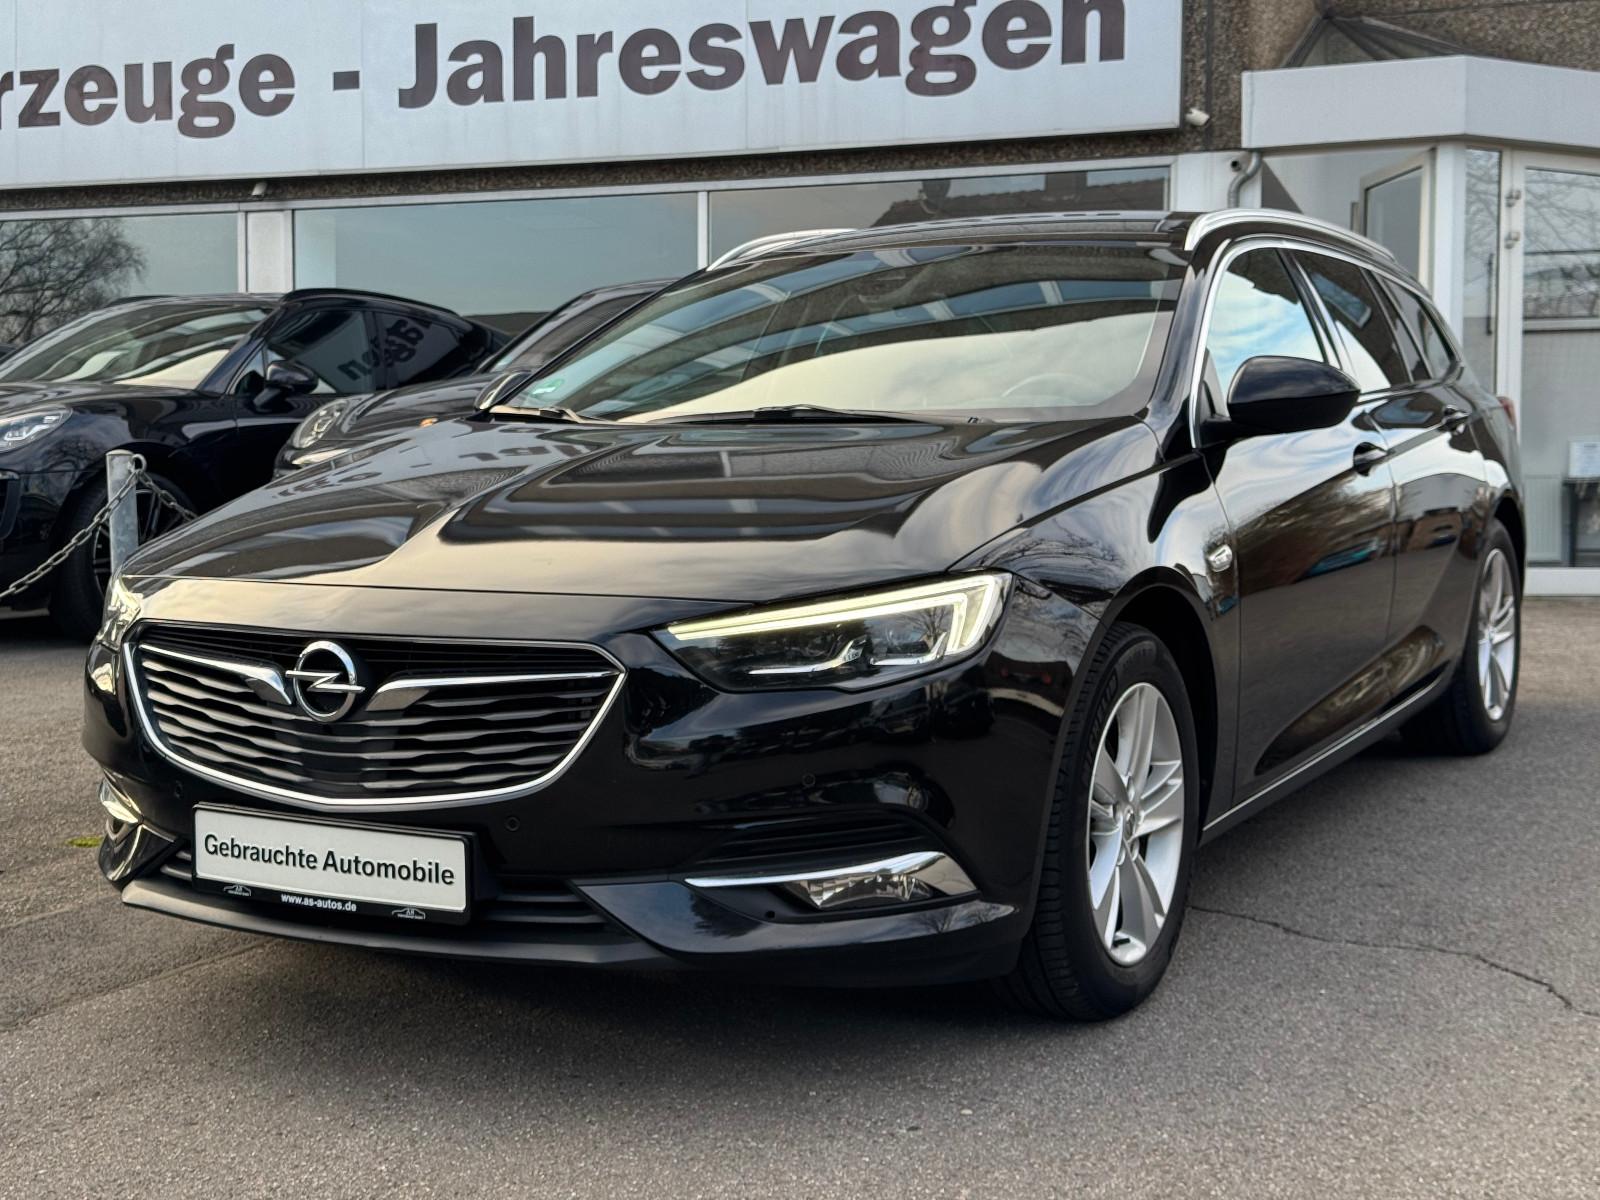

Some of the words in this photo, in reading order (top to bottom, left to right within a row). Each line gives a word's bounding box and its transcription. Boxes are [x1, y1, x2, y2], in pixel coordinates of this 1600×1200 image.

[333, 70, 361, 91] -
[398, 0, 1126, 109] Jahreswagen
[204, 833, 318, 870] Gebrauchte
[322, 850, 455, 885] Automobile
[281, 893, 357, 912] www.as-autos.de
